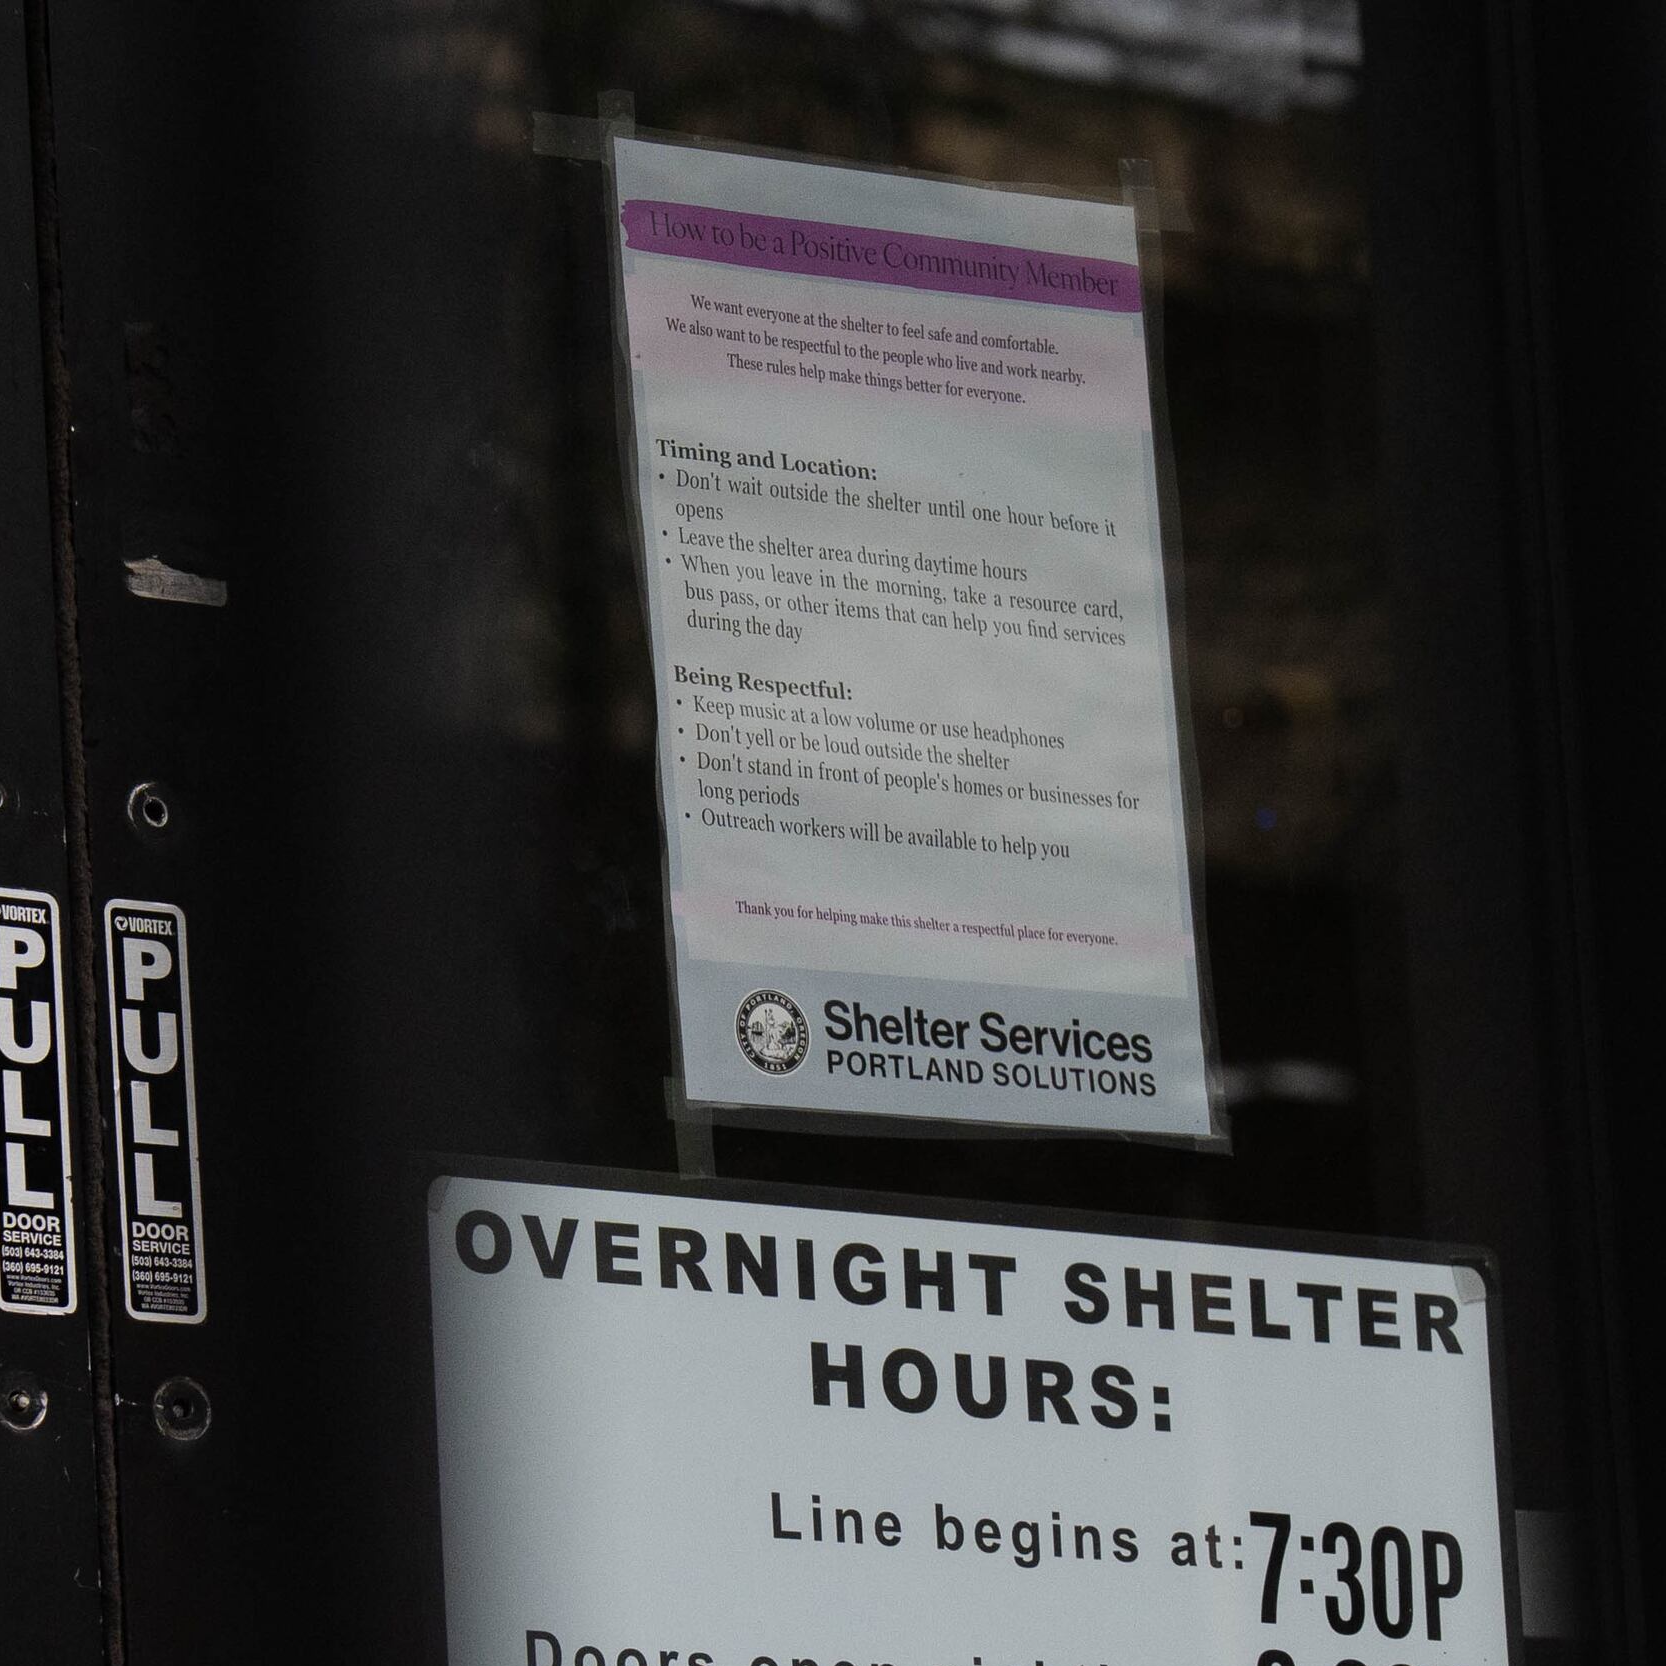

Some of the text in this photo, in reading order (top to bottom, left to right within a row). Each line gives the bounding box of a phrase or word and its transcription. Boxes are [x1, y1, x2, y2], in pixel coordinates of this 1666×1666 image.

[649, 210, 1119, 296] How to be a Positive Community Member
[727, 353, 1025, 404] These rules help make things better for everyone.
[656, 439, 876, 480] Timing and Location:
[676, 504, 723, 522] opens
[677, 469, 1116, 537] Don't wait outside the shelter until one hour before it
[681, 554, 1123, 620] When you leave in the morning, take a resource card,
[675, 666, 851, 700] Being Respectful:
[694, 696, 1064, 748] Keep music at a low volume or use headphones
[697, 724, 1009, 770] Don't yell or be loud outside the shelter
[702, 808, 1069, 860] Outreach workers will be available to help you
[1, 904, 46, 924] VORTEX
[128, 917, 172, 936] VORTEX
[735, 901, 1117, 946] Thank you for helping make this shelter a respectful place for everyone.
[825, 1000, 1152, 1063] Shelter Services
[121, 937, 182, 1218] PULL
[827, 1050, 1156, 1096] PORTLAND SOLUTIONS
[2, 1212, 60, 1232] DOOR
[3, 1230, 62, 1246] SERVICE
[132, 1221, 189, 1241] DOOR
[2, 1245, 64, 1260] (503) 643-3384
[2, 1260, 64, 1275] (360) 695-9121
[132, 1255, 193, 1269] (503) 643-3384
[133, 1240, 190, 1255] SERVICE
[132, 1269, 193, 1284] (360) 695-9121
[455, 1211, 1462, 1354] OVERNIGHT SHELTER
[811, 1342, 1171, 1432] HOURS:
[771, 1492, 1463, 1641] Line begins at: 7:30P
